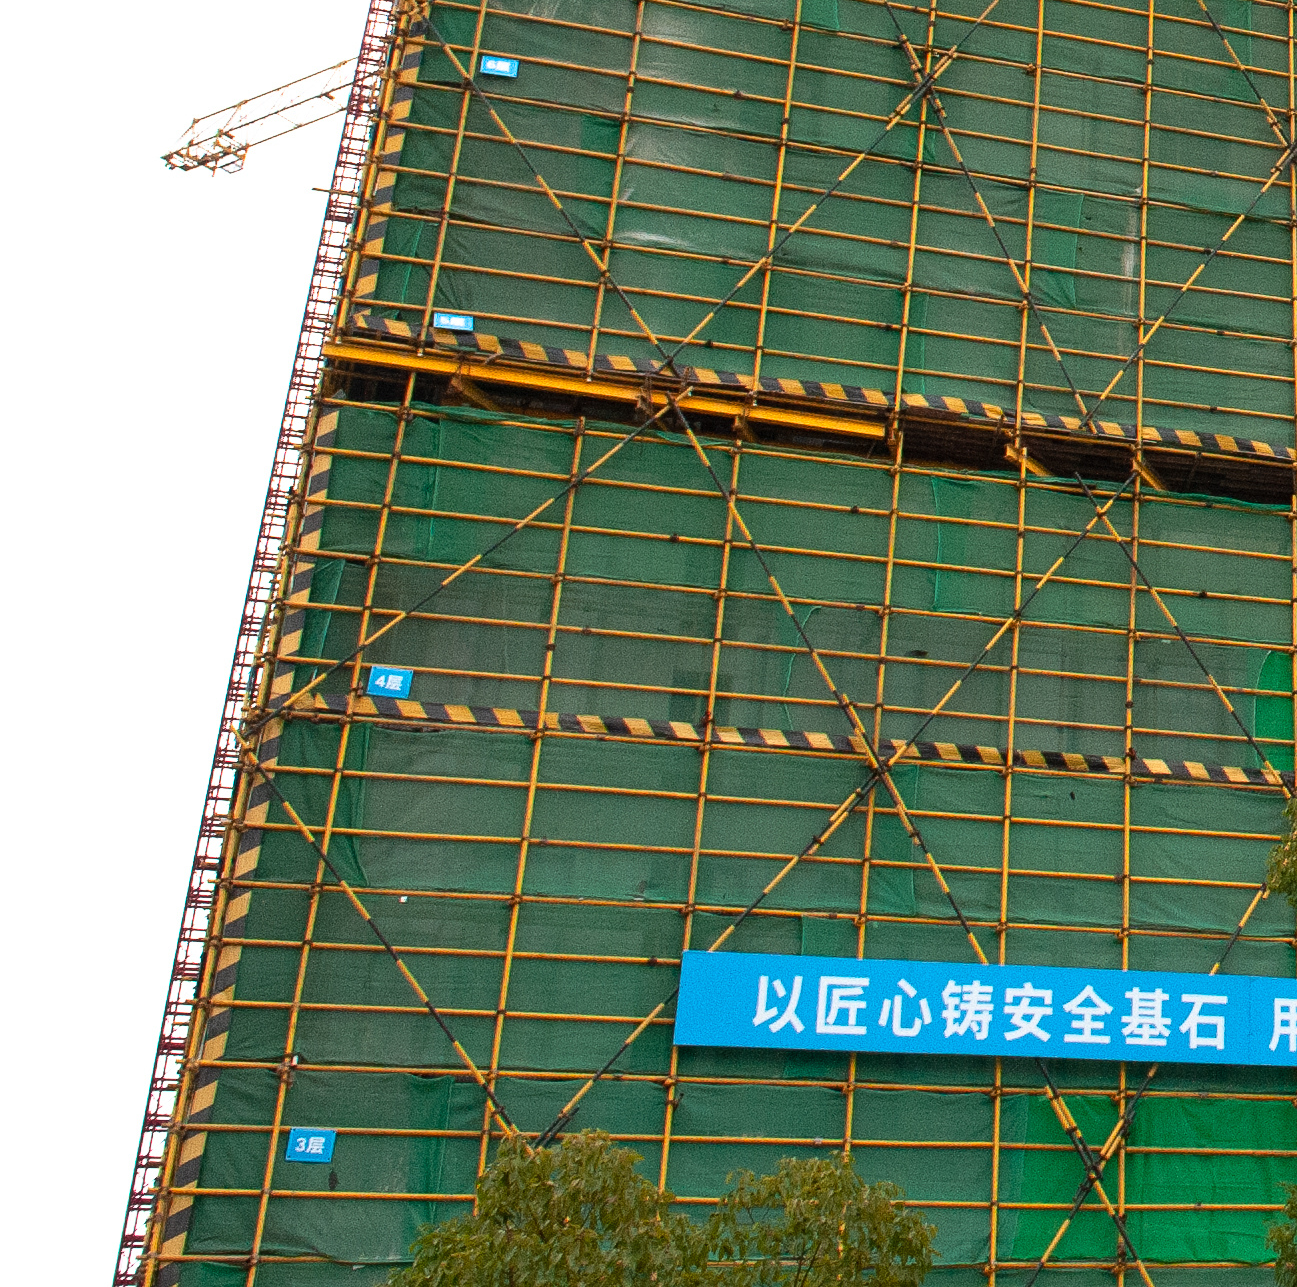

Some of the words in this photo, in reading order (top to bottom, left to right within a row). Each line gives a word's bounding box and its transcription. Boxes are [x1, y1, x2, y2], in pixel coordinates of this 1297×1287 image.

[374, 675, 403, 691] 4层
[752, 975, 1227, 1050] 以匠心铸安全基石
[295, 1137, 325, 1154] 3层
